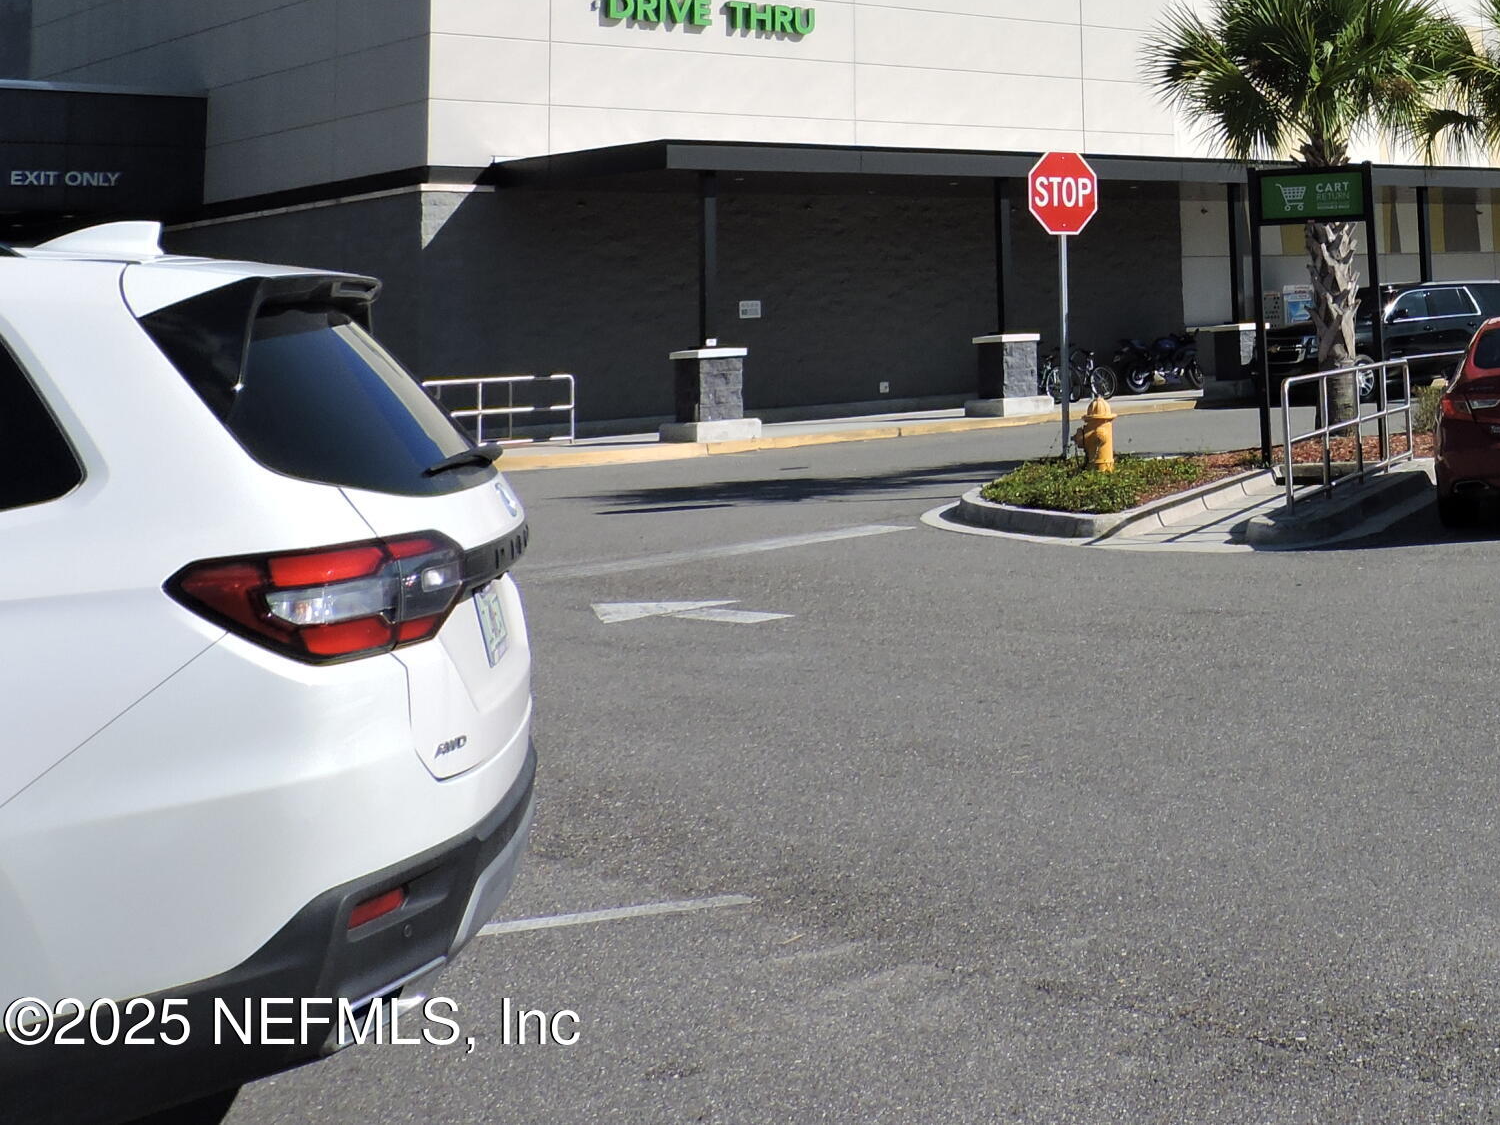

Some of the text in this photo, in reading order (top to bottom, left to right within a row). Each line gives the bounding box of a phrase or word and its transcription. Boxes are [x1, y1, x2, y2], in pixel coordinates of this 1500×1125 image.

[726, 0, 816, 35] THRU
[10, 170, 121, 187] EXIT ONLY
[1315, 182, 1349, 193] CART
[1034, 176, 1092, 208] STOP
[433, 735, 468, 760] AWD
